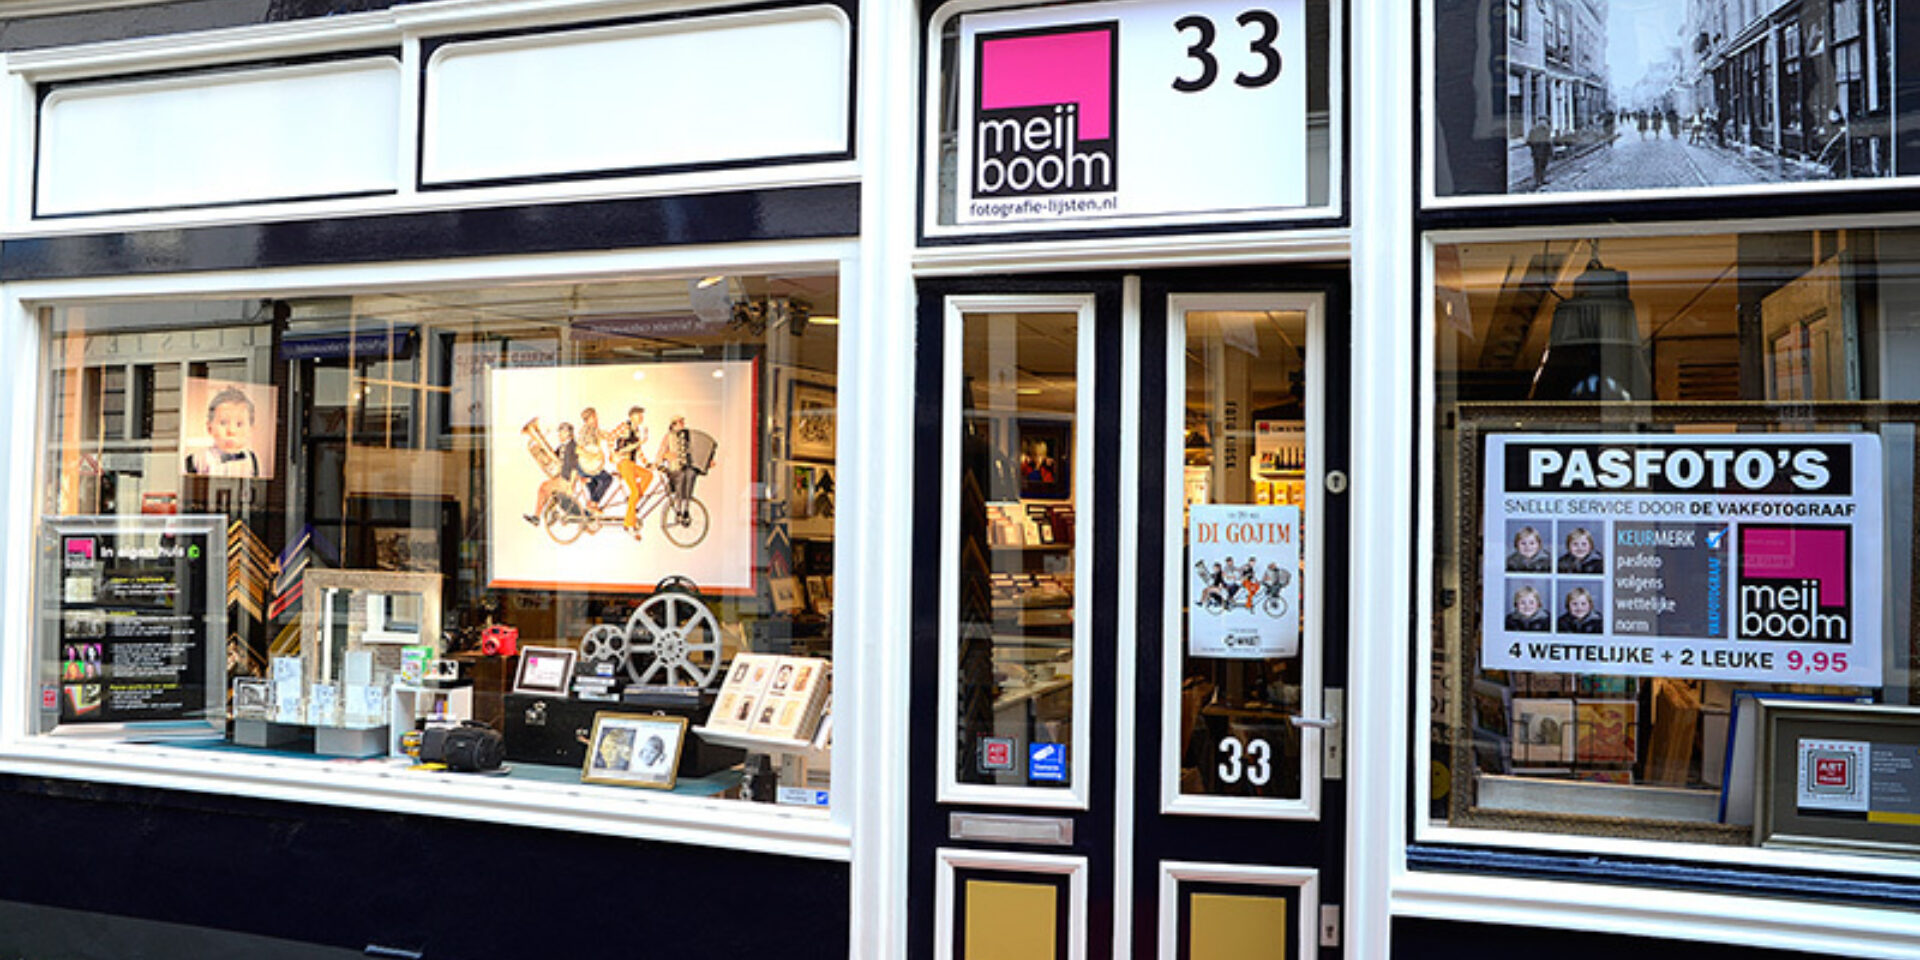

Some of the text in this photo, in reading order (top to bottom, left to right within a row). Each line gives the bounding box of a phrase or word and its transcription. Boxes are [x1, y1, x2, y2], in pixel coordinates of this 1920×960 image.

[1171, 9, 1283, 93] 33
[978, 104, 1076, 155] meij
[978, 150, 1111, 193] boom
[969, 196, 1118, 218] fotografie-lijsten.nl
[1504, 499, 1856, 518] SNELLE SERVICE DOOR DE VAKFOTOGRAAF
[1197, 522, 1291, 544] DI GOJIM
[1617, 529, 1696, 548] KEURMERK
[1617, 552, 1663, 570] pasfoto
[1616, 575, 1664, 593] volgens
[1616, 596, 1677, 615] wettelijke
[1741, 579, 1818, 612] meij
[1615, 619, 1650, 632] norm
[1741, 609, 1846, 639] boom
[1508, 643, 1522, 659] 4
[1528, 643, 1654, 664] WETTELIJKE
[1680, 649, 1694, 666] 2
[1701, 651, 1774, 670] LEUKE
[1786, 650, 1849, 675] 9,95
[1217, 736, 1272, 787] 33
